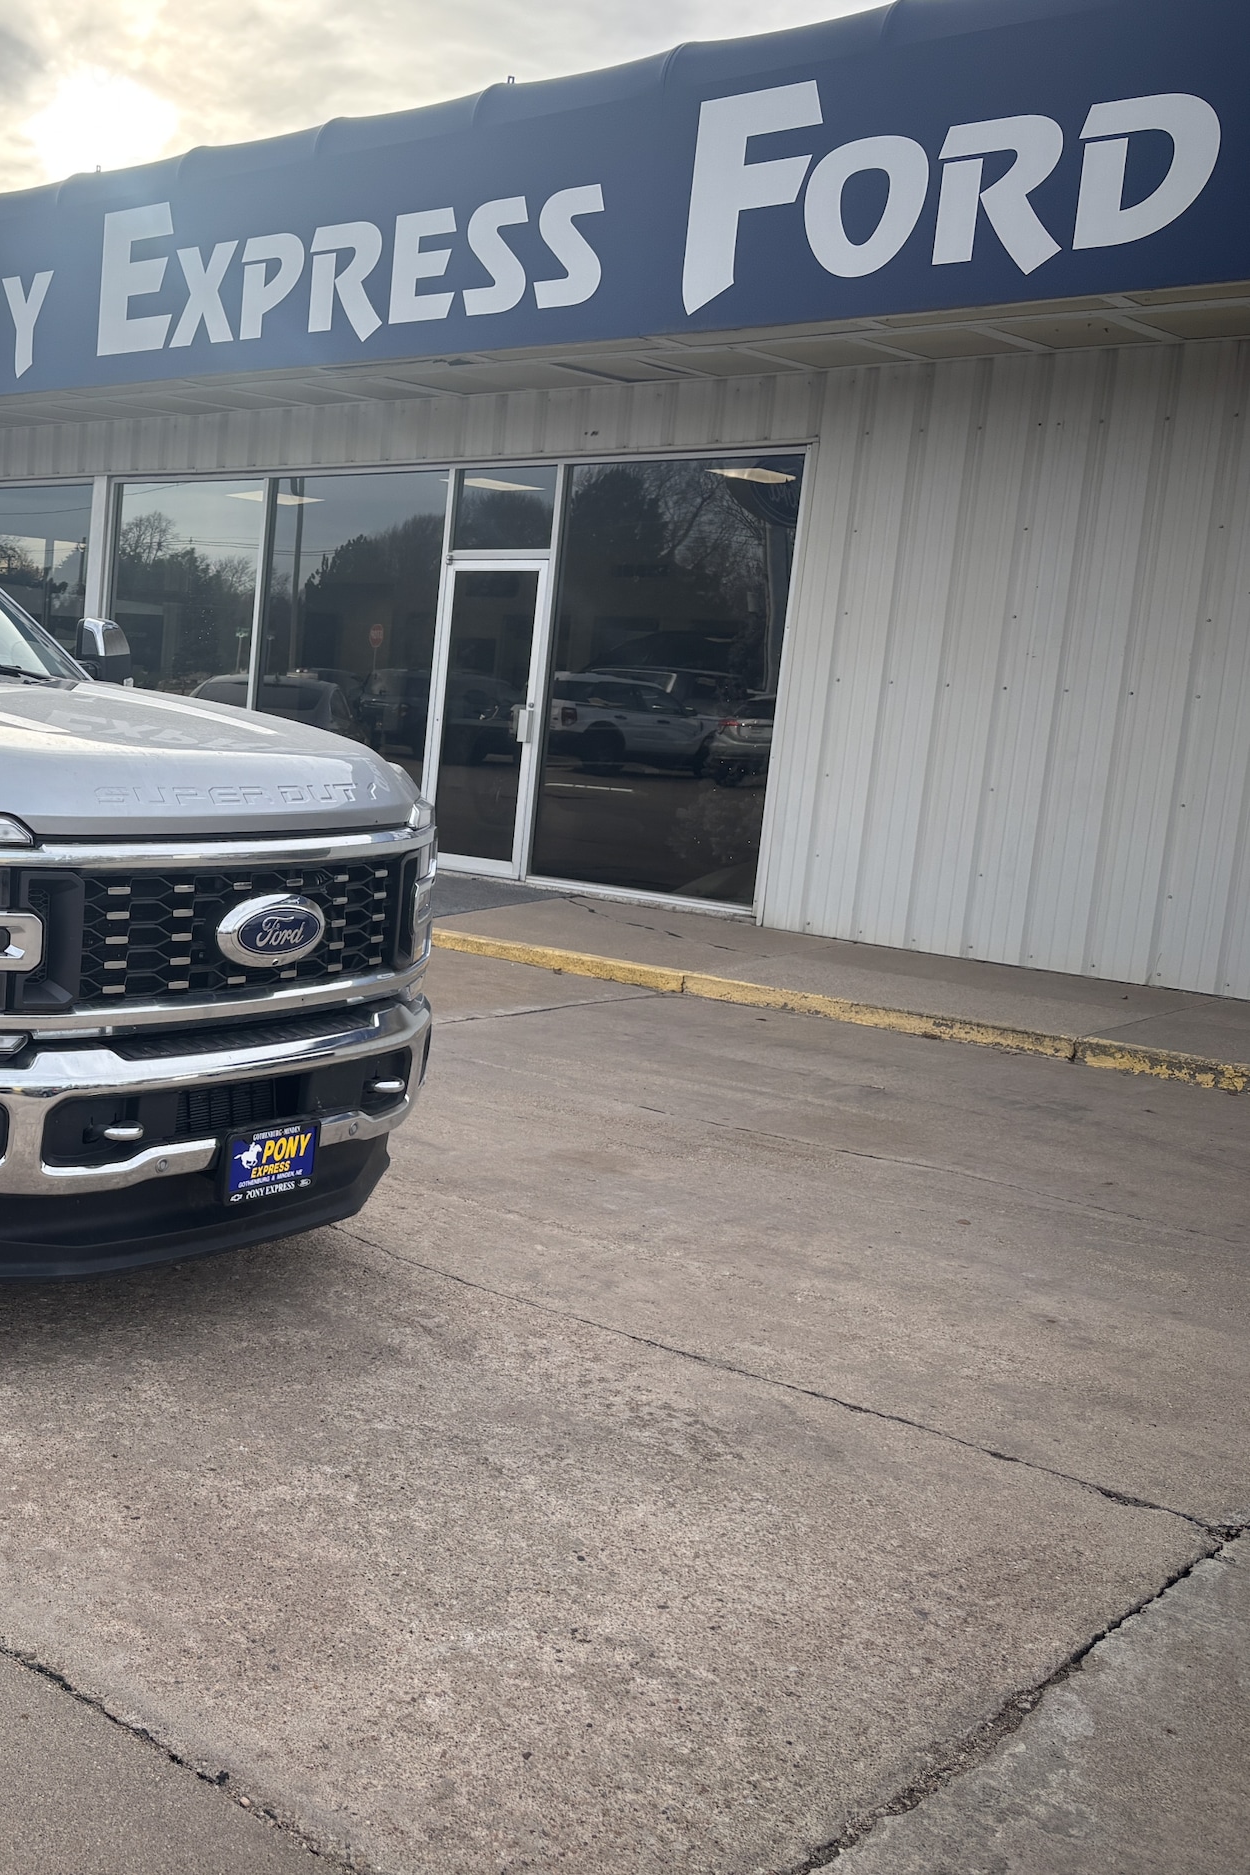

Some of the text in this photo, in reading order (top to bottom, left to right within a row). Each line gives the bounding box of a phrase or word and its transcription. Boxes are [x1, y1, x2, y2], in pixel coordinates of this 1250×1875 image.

[97, 183, 604, 357] EXPRESS
[682, 79, 1221, 316] FORD
[255, 916, 305, 948] Ford
[262, 1133, 312, 1163] PONY
[251, 1161, 290, 1178] EXPRESS
[246, 1187, 265, 1199] PONY
[265, 1181, 295, 1195] EXPRESS
